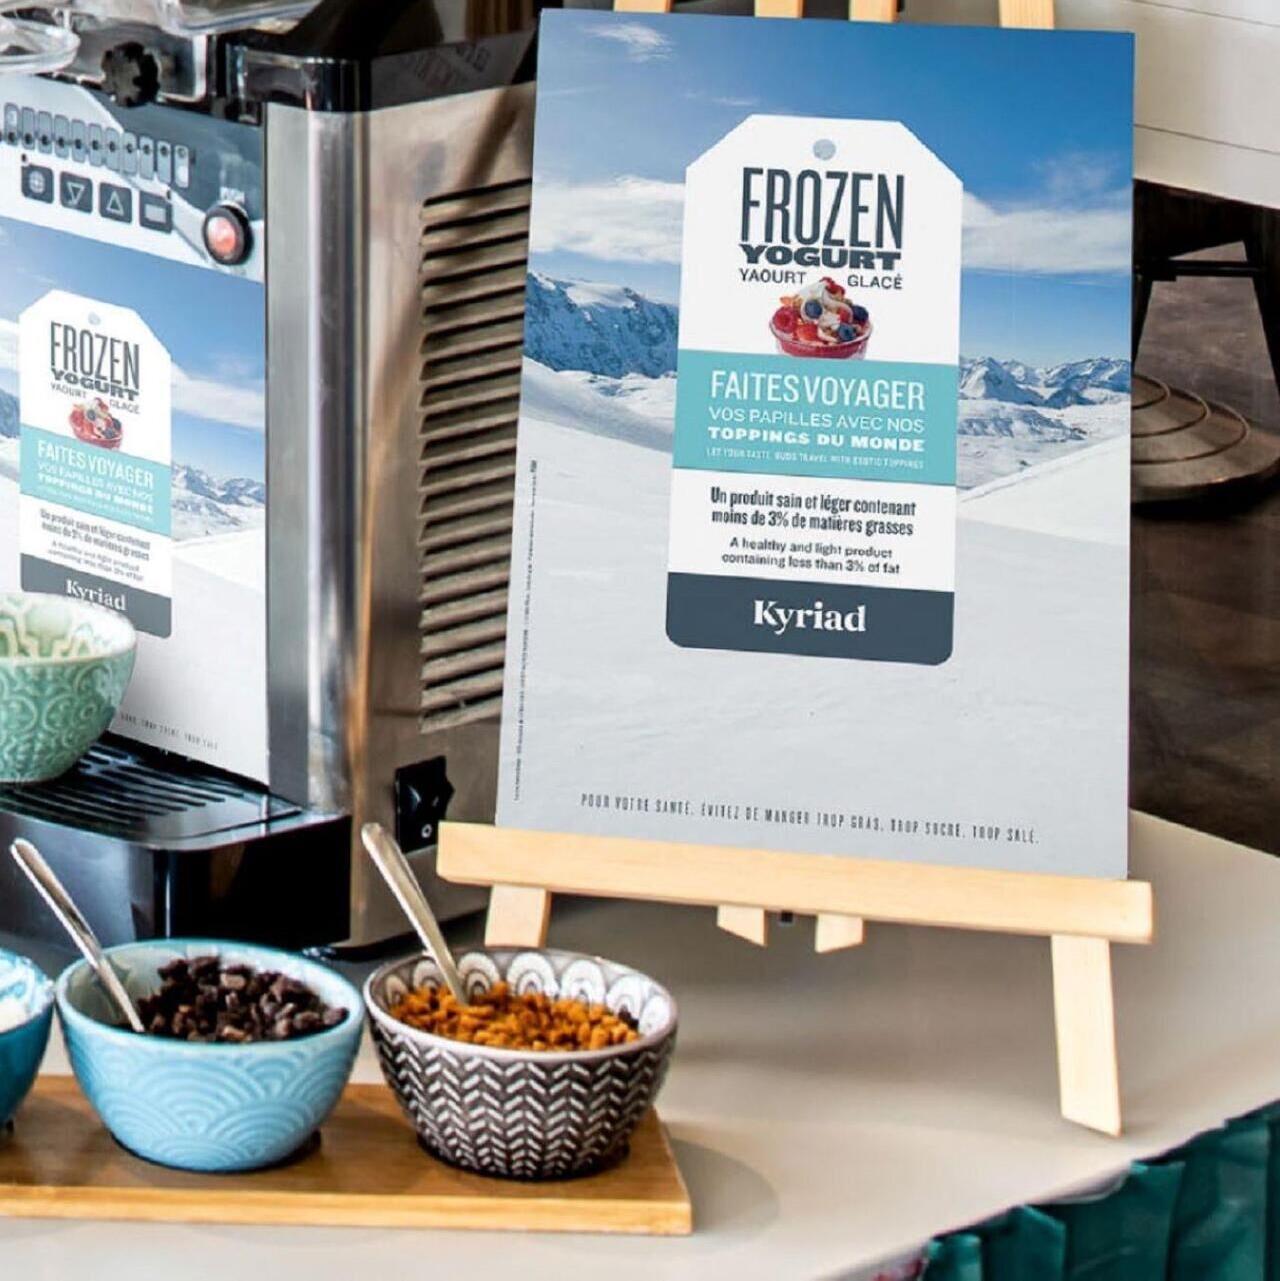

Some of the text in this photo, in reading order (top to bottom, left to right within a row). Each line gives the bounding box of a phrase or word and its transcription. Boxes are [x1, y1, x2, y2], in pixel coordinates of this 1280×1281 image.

[741, 166, 906, 250] FROZEN
[738, 243, 902, 271] YOGURT
[739, 268, 904, 290] YAOURT GLACÉ
[49, 320, 140, 391] FROZEN
[51, 368, 140, 403] YOGURT
[51, 381, 88, 400] YAOURT
[710, 370, 926, 412] FAITES VOYAGER
[708, 407, 925, 434] VOS PAPILLES AVEC NOS
[707, 426, 926, 453] TOPPINGS DU MONDE
[37, 439, 154, 490] FAITES VOYAGER
[711, 486, 917, 517] Un produit sain et léger contenant
[711, 509, 914, 538] moins de 3% de matières grasses
[721, 552, 901, 575] containing less than 3% of fat
[729, 537, 894, 562] A healthy and light product
[65, 577, 128, 612] Kyriad
[753, 600, 868, 636] Kyriad
